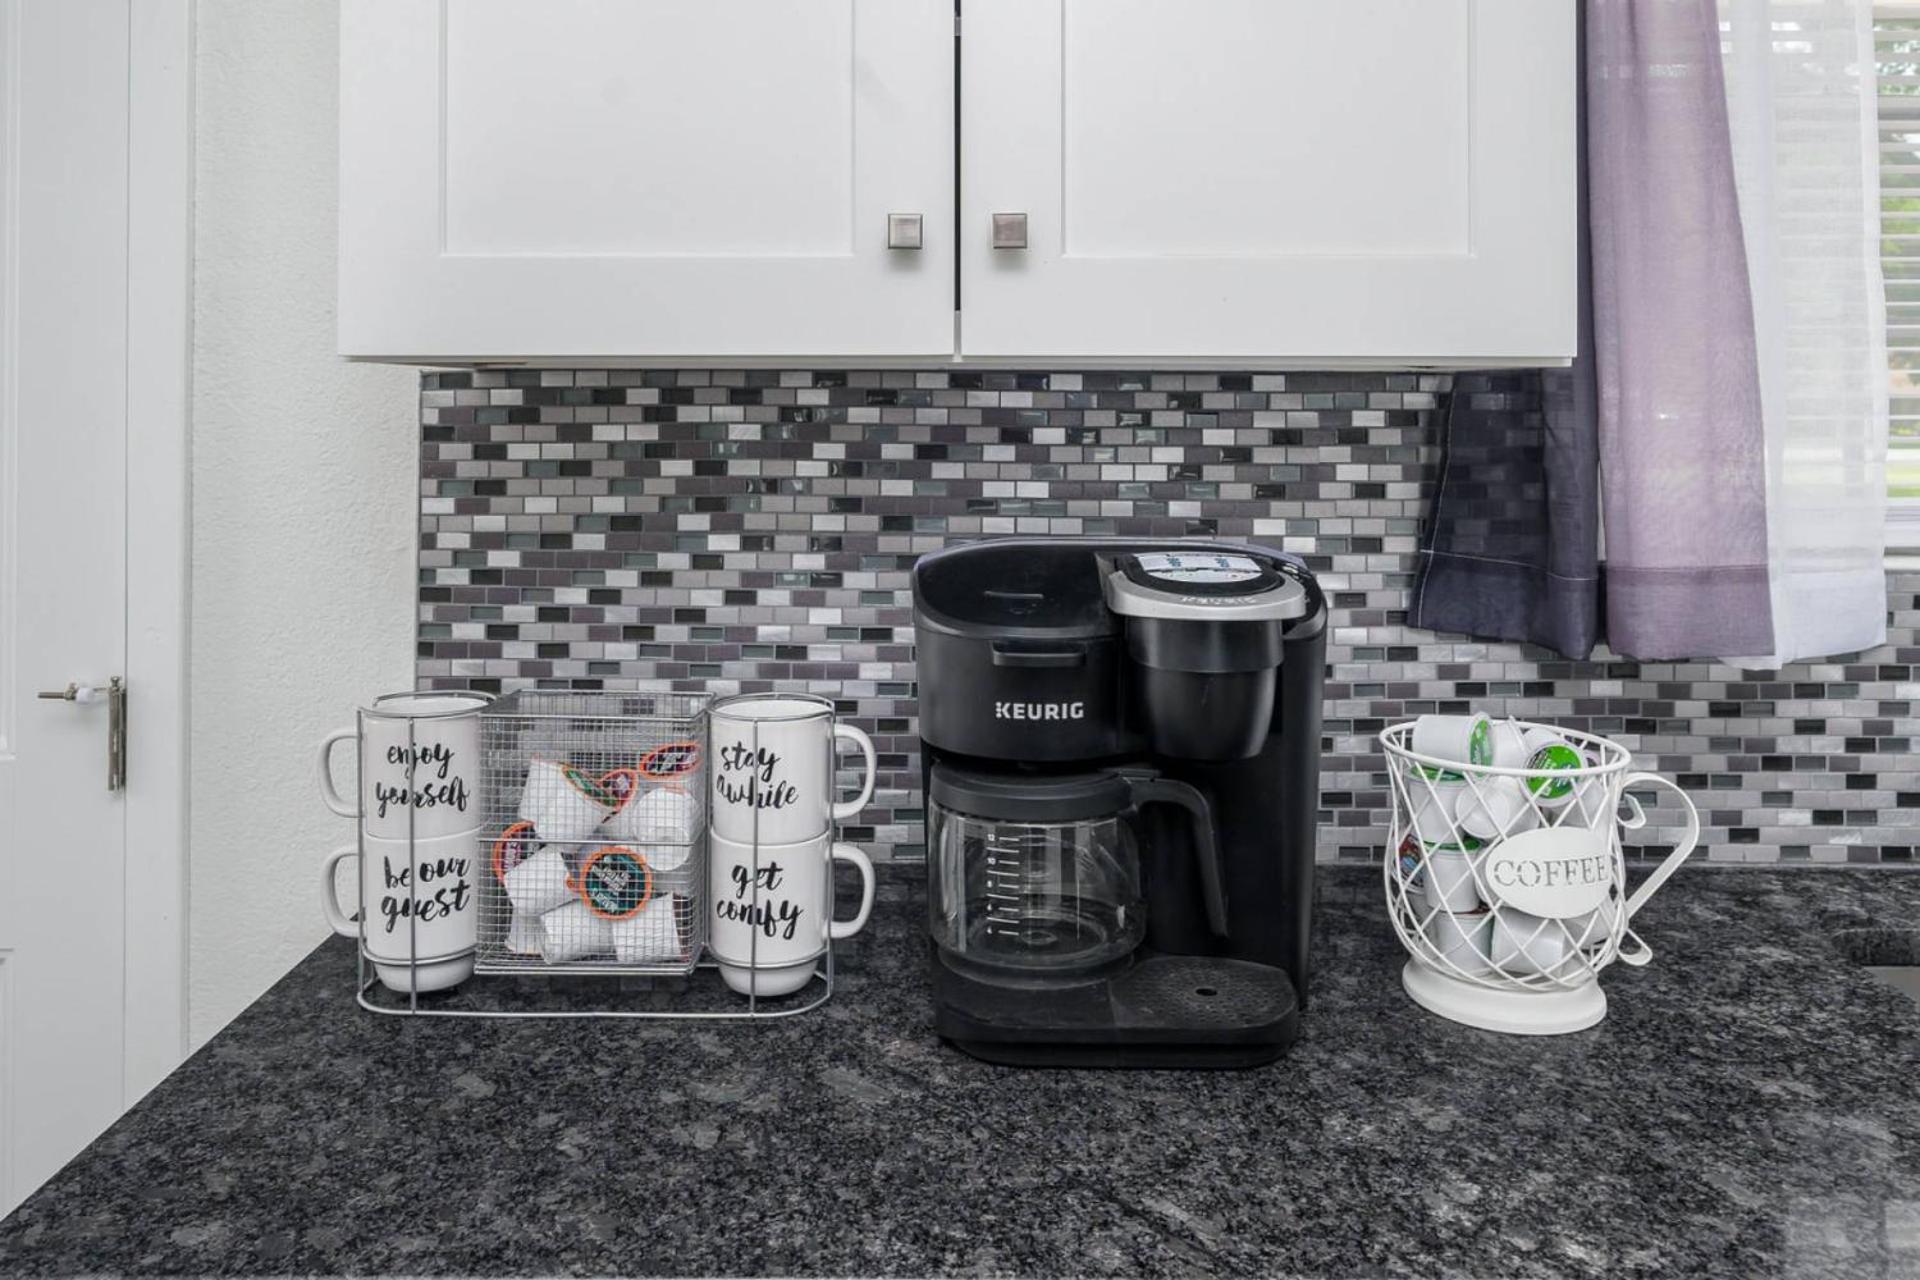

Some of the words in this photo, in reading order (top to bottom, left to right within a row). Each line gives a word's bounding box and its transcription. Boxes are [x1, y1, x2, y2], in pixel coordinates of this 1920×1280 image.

[995, 702, 1084, 720] KEURIG
[387, 742, 455, 780] enjoy
[721, 741, 782, 782] stay
[375, 776, 471, 818] yourself
[384, 856, 410, 888] be
[420, 857, 471, 882] our
[731, 861, 784, 899] get
[1494, 855, 1609, 888] COFFEE
[381, 879, 471, 933] guest
[717, 899, 804, 940] comfy
